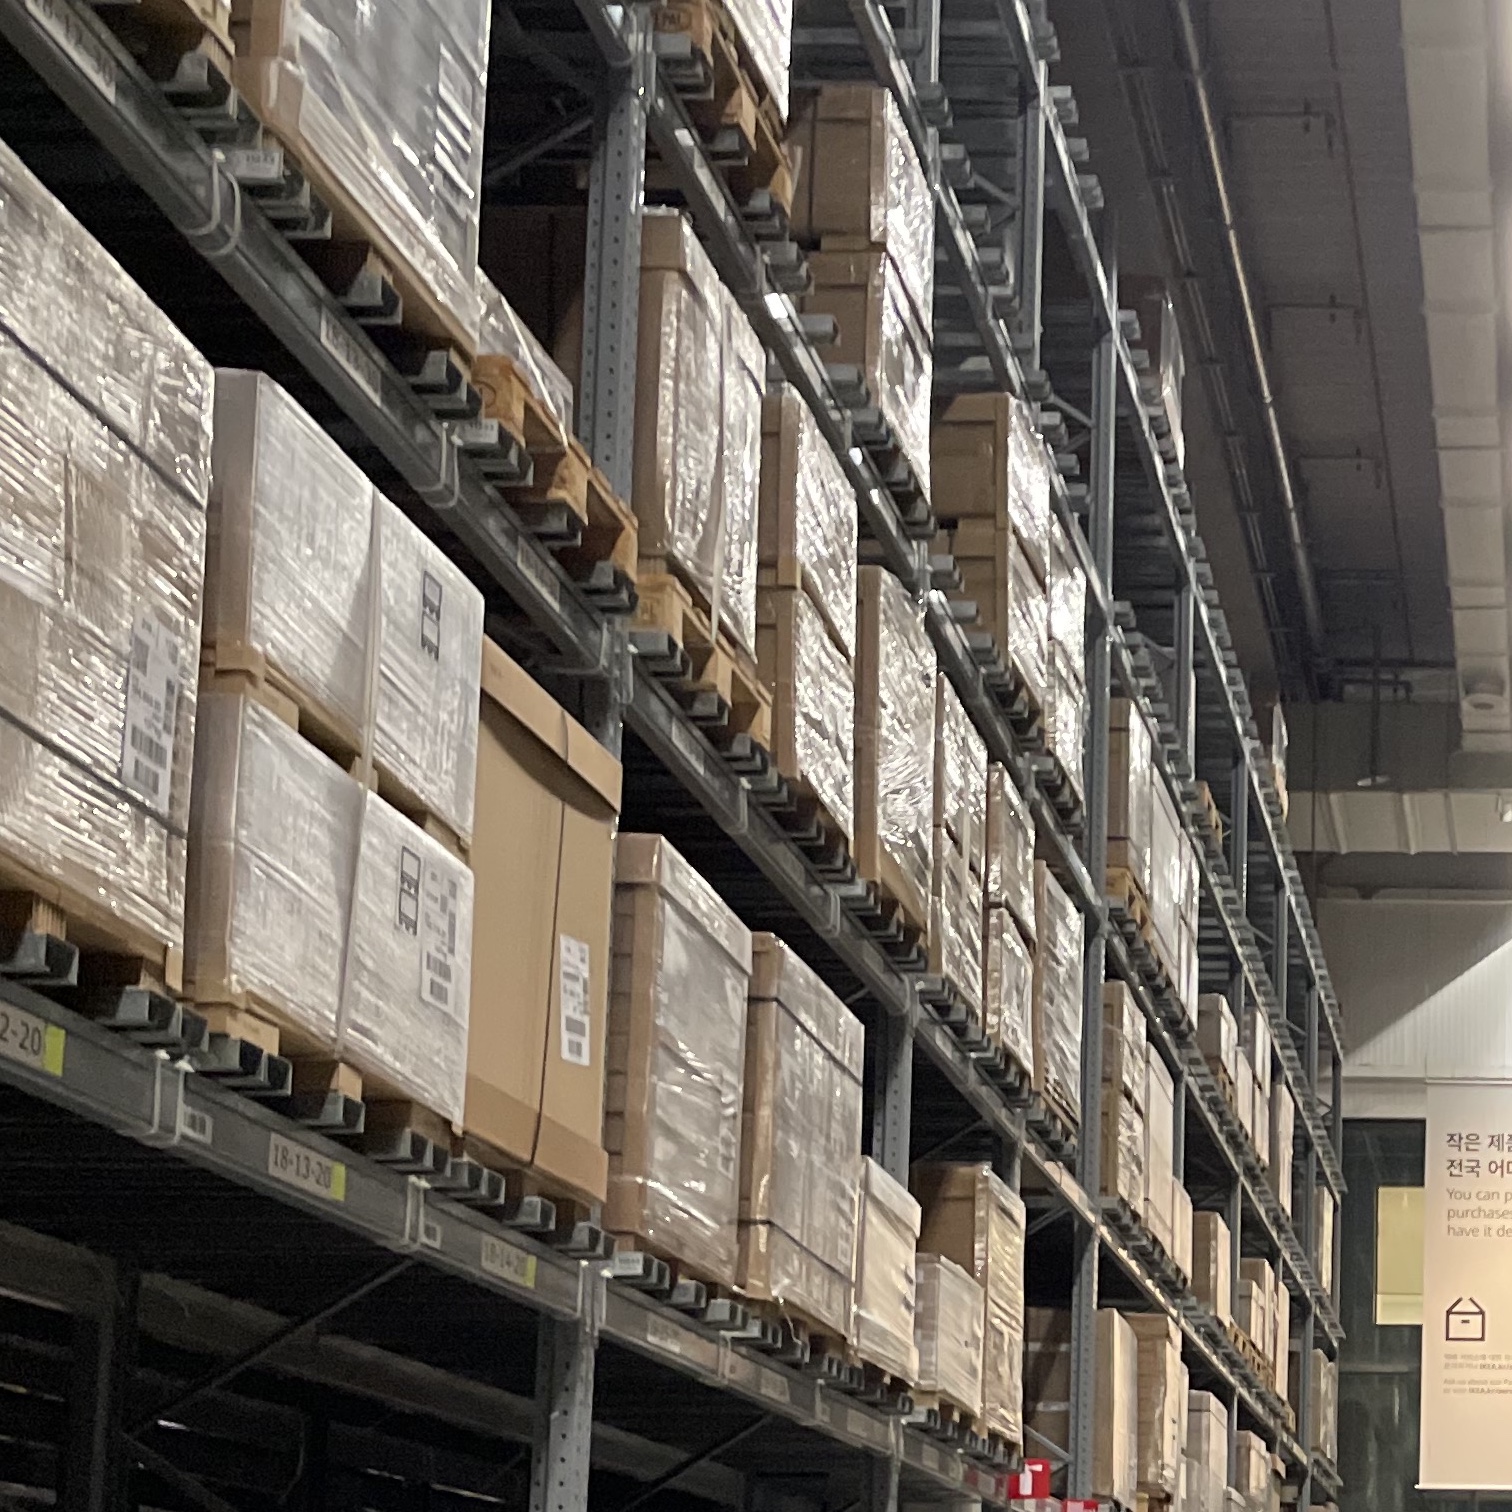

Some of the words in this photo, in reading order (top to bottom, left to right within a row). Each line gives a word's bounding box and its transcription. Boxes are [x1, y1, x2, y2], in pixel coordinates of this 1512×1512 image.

[1446, 1132, 1481, 1152] 작은
[273, 1143, 332, 1189] 18-13-20
[1446, 1159, 1481, 1178] 전국
[1446, 1188, 1471, 1201] You
[1476, 1190, 1500, 1201] can
[1447, 1224, 1480, 1237] have
[1484, 1225, 1492, 1237] it
